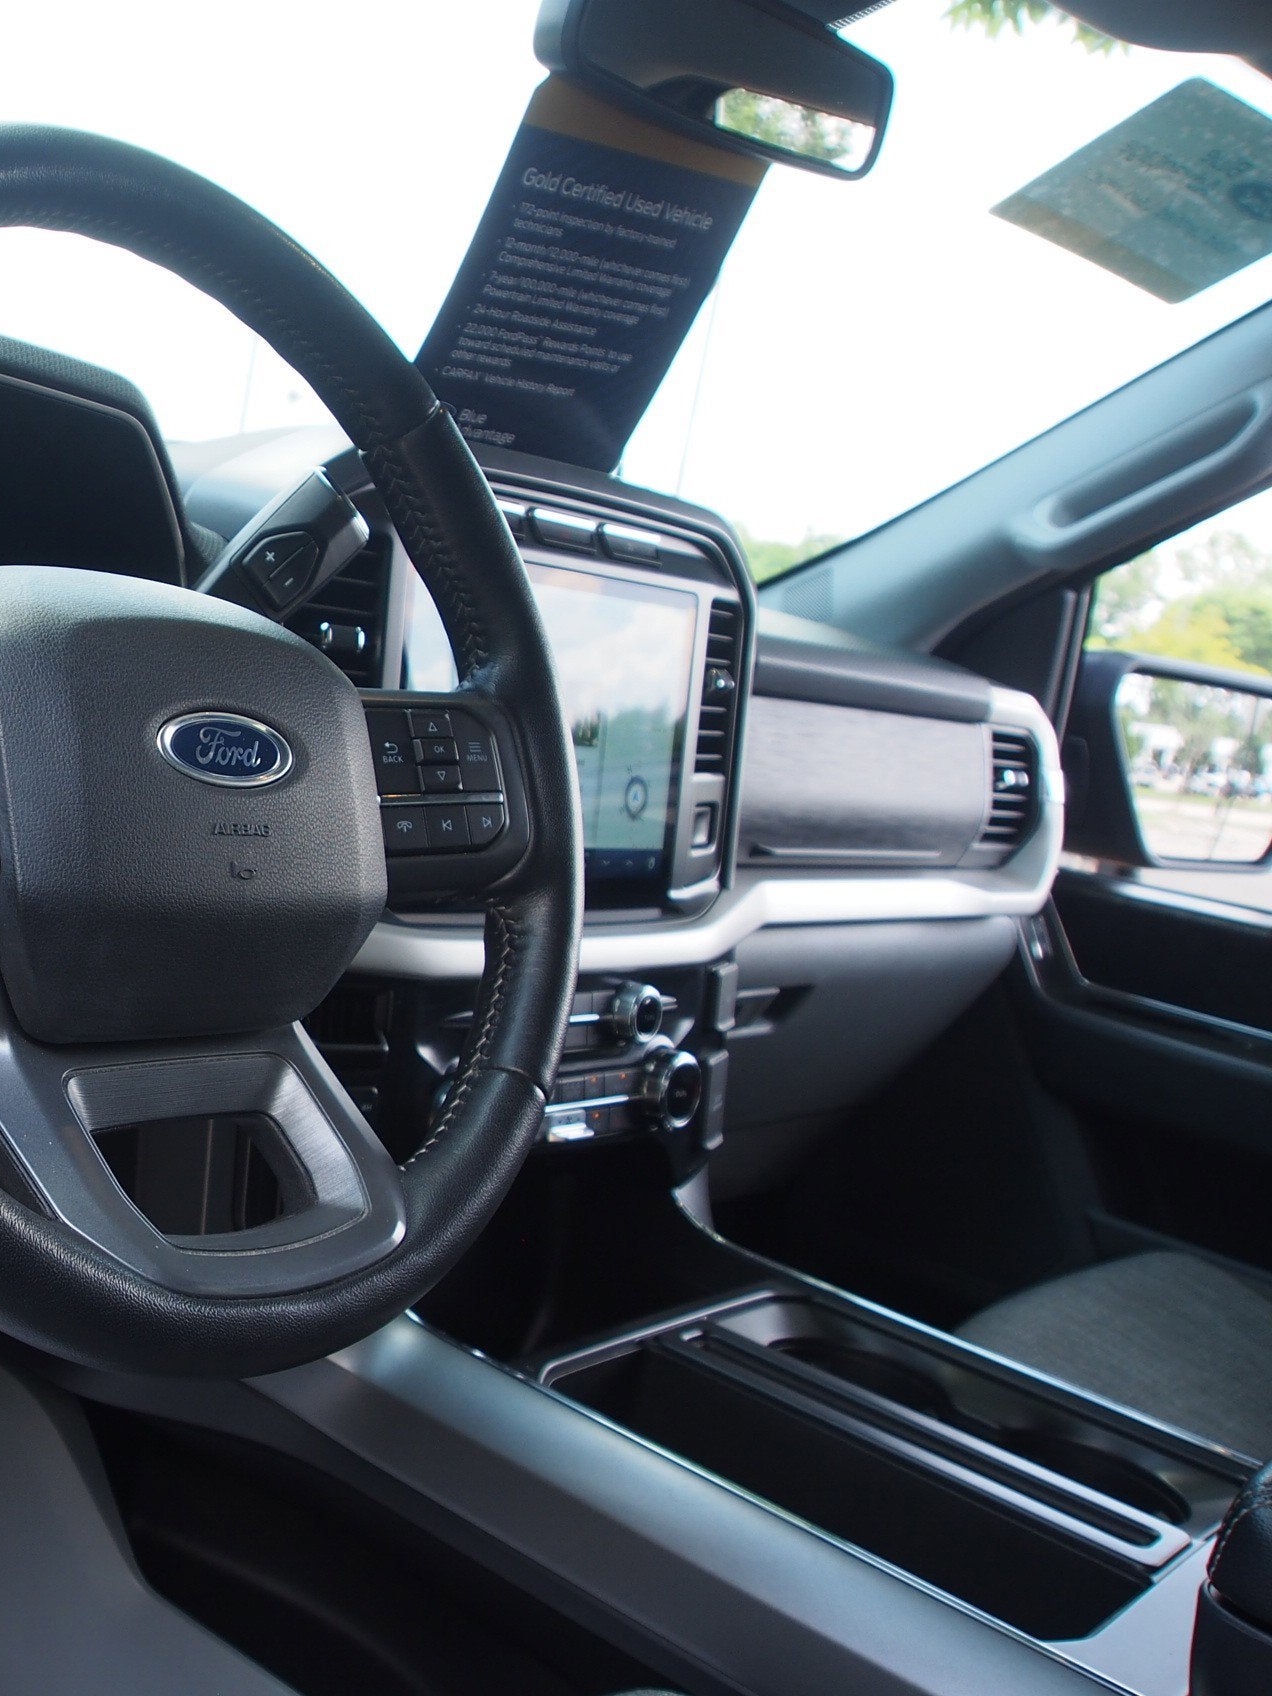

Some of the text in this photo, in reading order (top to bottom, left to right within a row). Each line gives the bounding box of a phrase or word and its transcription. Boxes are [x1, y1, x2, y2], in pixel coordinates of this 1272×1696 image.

[522, 167, 715, 230] Gold Certified Used Vehicle
[513, 219, 564, 236] technicians
[560, 213, 605, 232] inspection
[616, 226, 677, 248] factory-trained
[499, 252, 671, 298] Comprehensive Limited Warranty coverage
[644, 270, 670, 282] comes
[484, 285, 639, 325] Powertrain Limited Warranty coverage
[511, 311, 551, 327] Roadside
[552, 319, 597, 336] Assistance
[459, 336, 489, 349] toward
[490, 341, 536, 358] scheduled
[537, 350, 588, 368] maintenance
[544, 338, 579, 352] Rewards
[451, 349, 511, 368] other rewards
[485, 374, 516, 387] Vehicle
[517, 379, 545, 392] History
[546, 384, 575, 398] Report
[458, 408, 488, 424] Blue
[195, 726, 262, 768] Ford
[433, 744, 445, 754] OK
[381, 755, 405, 764] BACK
[466, 754, 488, 762] MENU
[213, 822, 272, 838] AIRBAG
